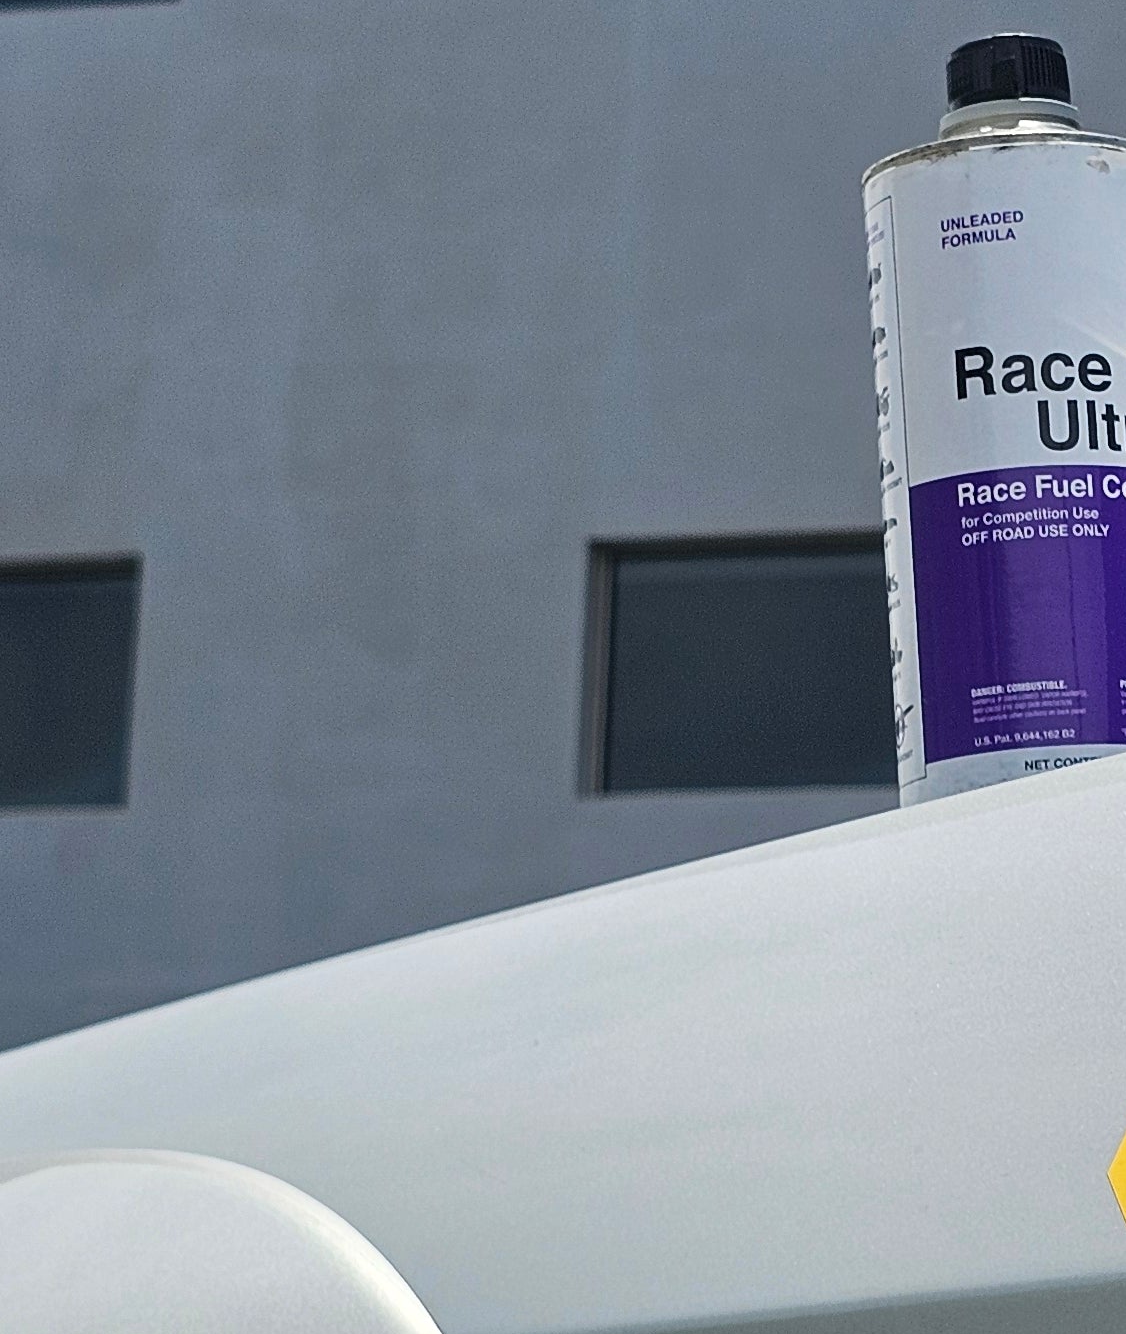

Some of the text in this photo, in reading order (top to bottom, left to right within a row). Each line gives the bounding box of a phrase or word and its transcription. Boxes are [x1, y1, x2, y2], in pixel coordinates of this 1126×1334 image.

[941, 210, 1024, 233] UNLEADED
[941, 228, 1016, 250] FORMULA
[955, 346, 1112, 400] Race
[957, 481, 1027, 507] Race
[1035, 474, 1094, 499] Fuel
[961, 506, 1100, 529] for Competition Use
[961, 523, 1111, 547] OFF ROAD USE ONLY
[994, 733, 1013, 744] Pat.
[1024, 759, 1050, 771] NET
